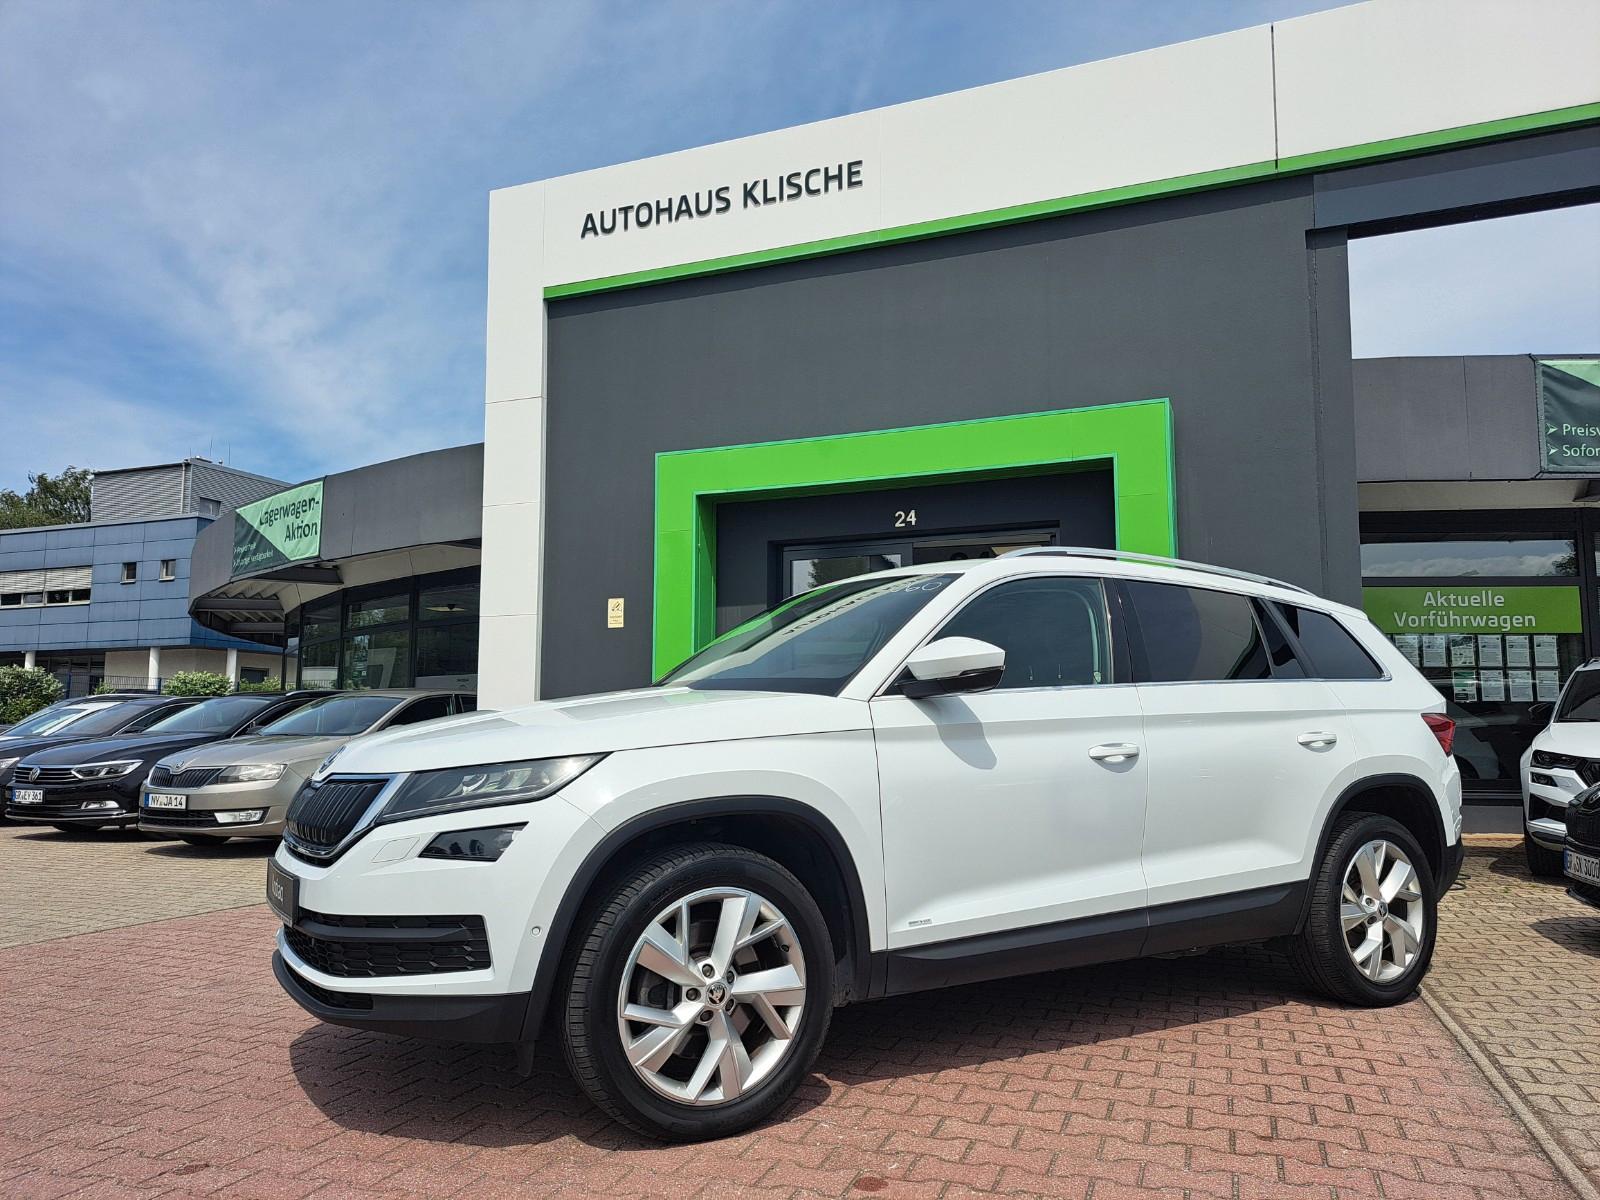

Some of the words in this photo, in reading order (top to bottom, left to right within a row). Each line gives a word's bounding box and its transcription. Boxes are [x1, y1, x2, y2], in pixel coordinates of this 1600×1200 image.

[581, 186, 731, 239] AUTOHAUS
[743, 160, 863, 209] KLISCHE
[260, 497, 319, 527] Lagerwagen-
[894, 509, 917, 527] 24
[284, 520, 318, 543] Aktion
[1423, 591, 1505, 607] Aktuelle
[1394, 611, 1536, 631] Vorführwagen
